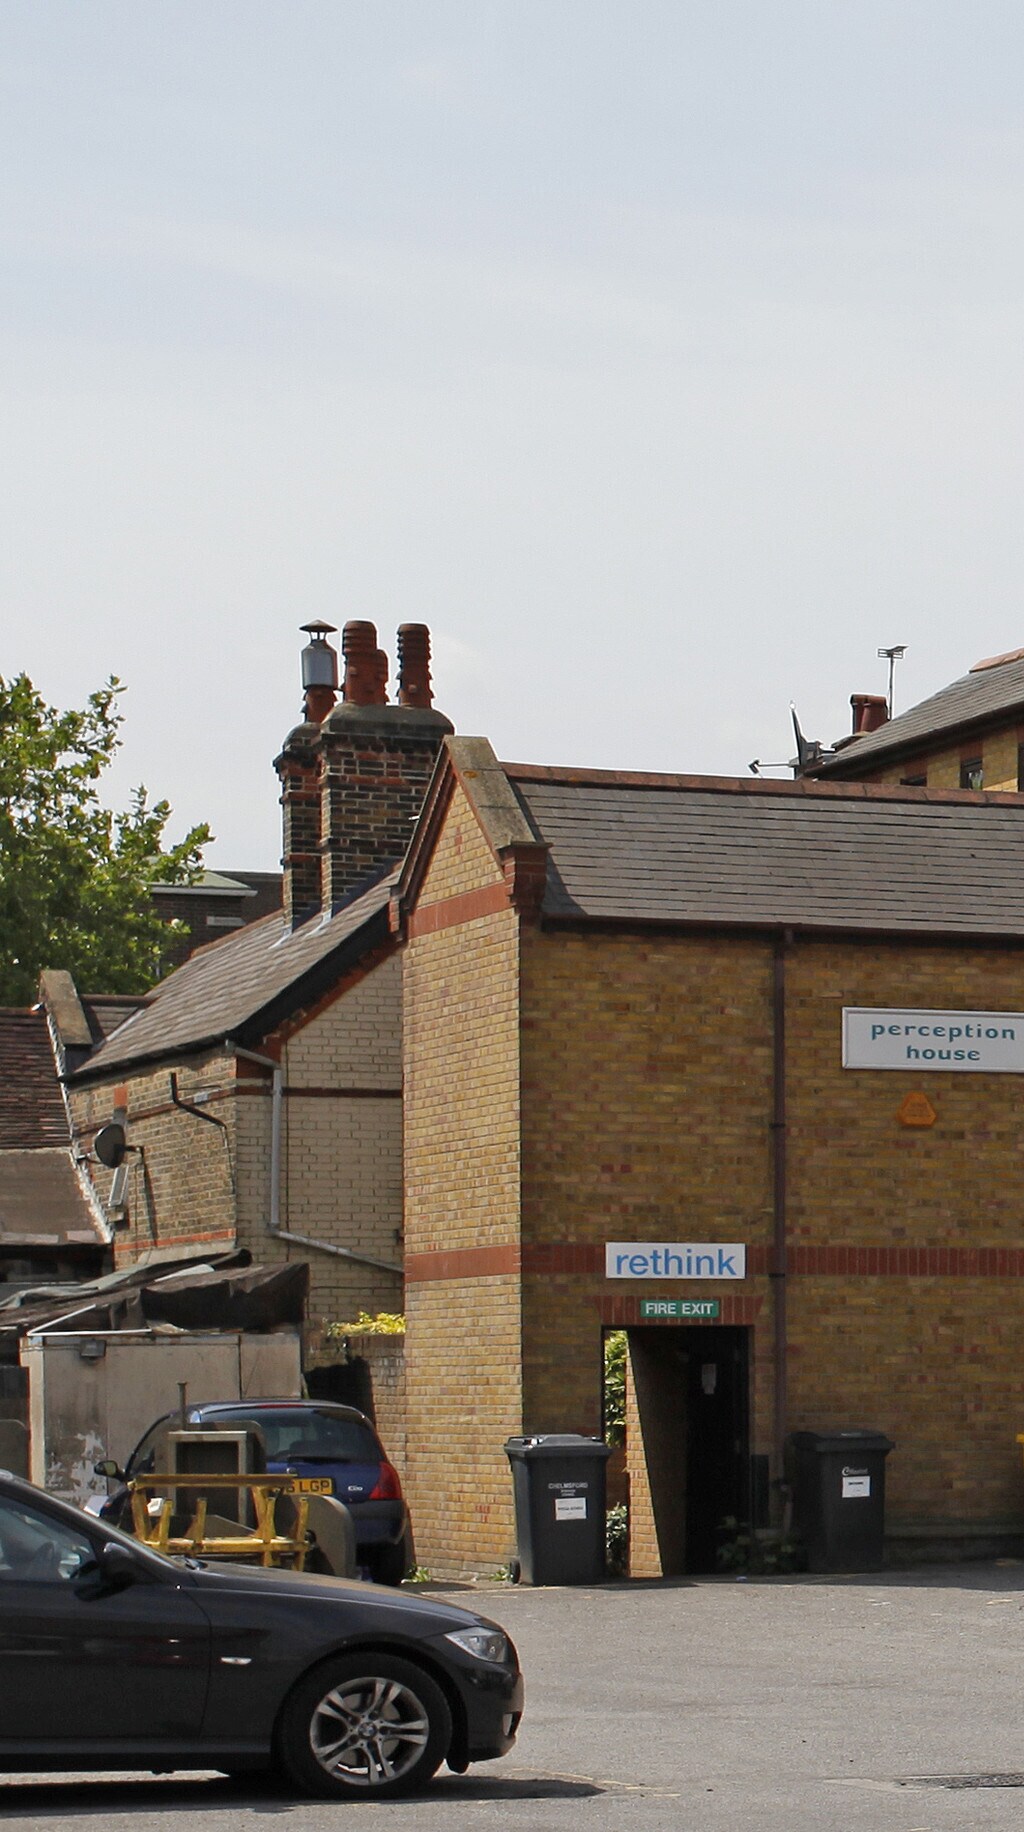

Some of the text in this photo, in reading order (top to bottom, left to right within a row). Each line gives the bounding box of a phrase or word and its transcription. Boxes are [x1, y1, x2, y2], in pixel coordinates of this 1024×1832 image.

[871, 1024, 1016, 1043] perception
[906, 1045, 981, 1061] house
[616, 1248, 737, 1276] rethink
[645, 1303, 714, 1315] FIRE EXIT
[299, 1480, 330, 1493] LGP
